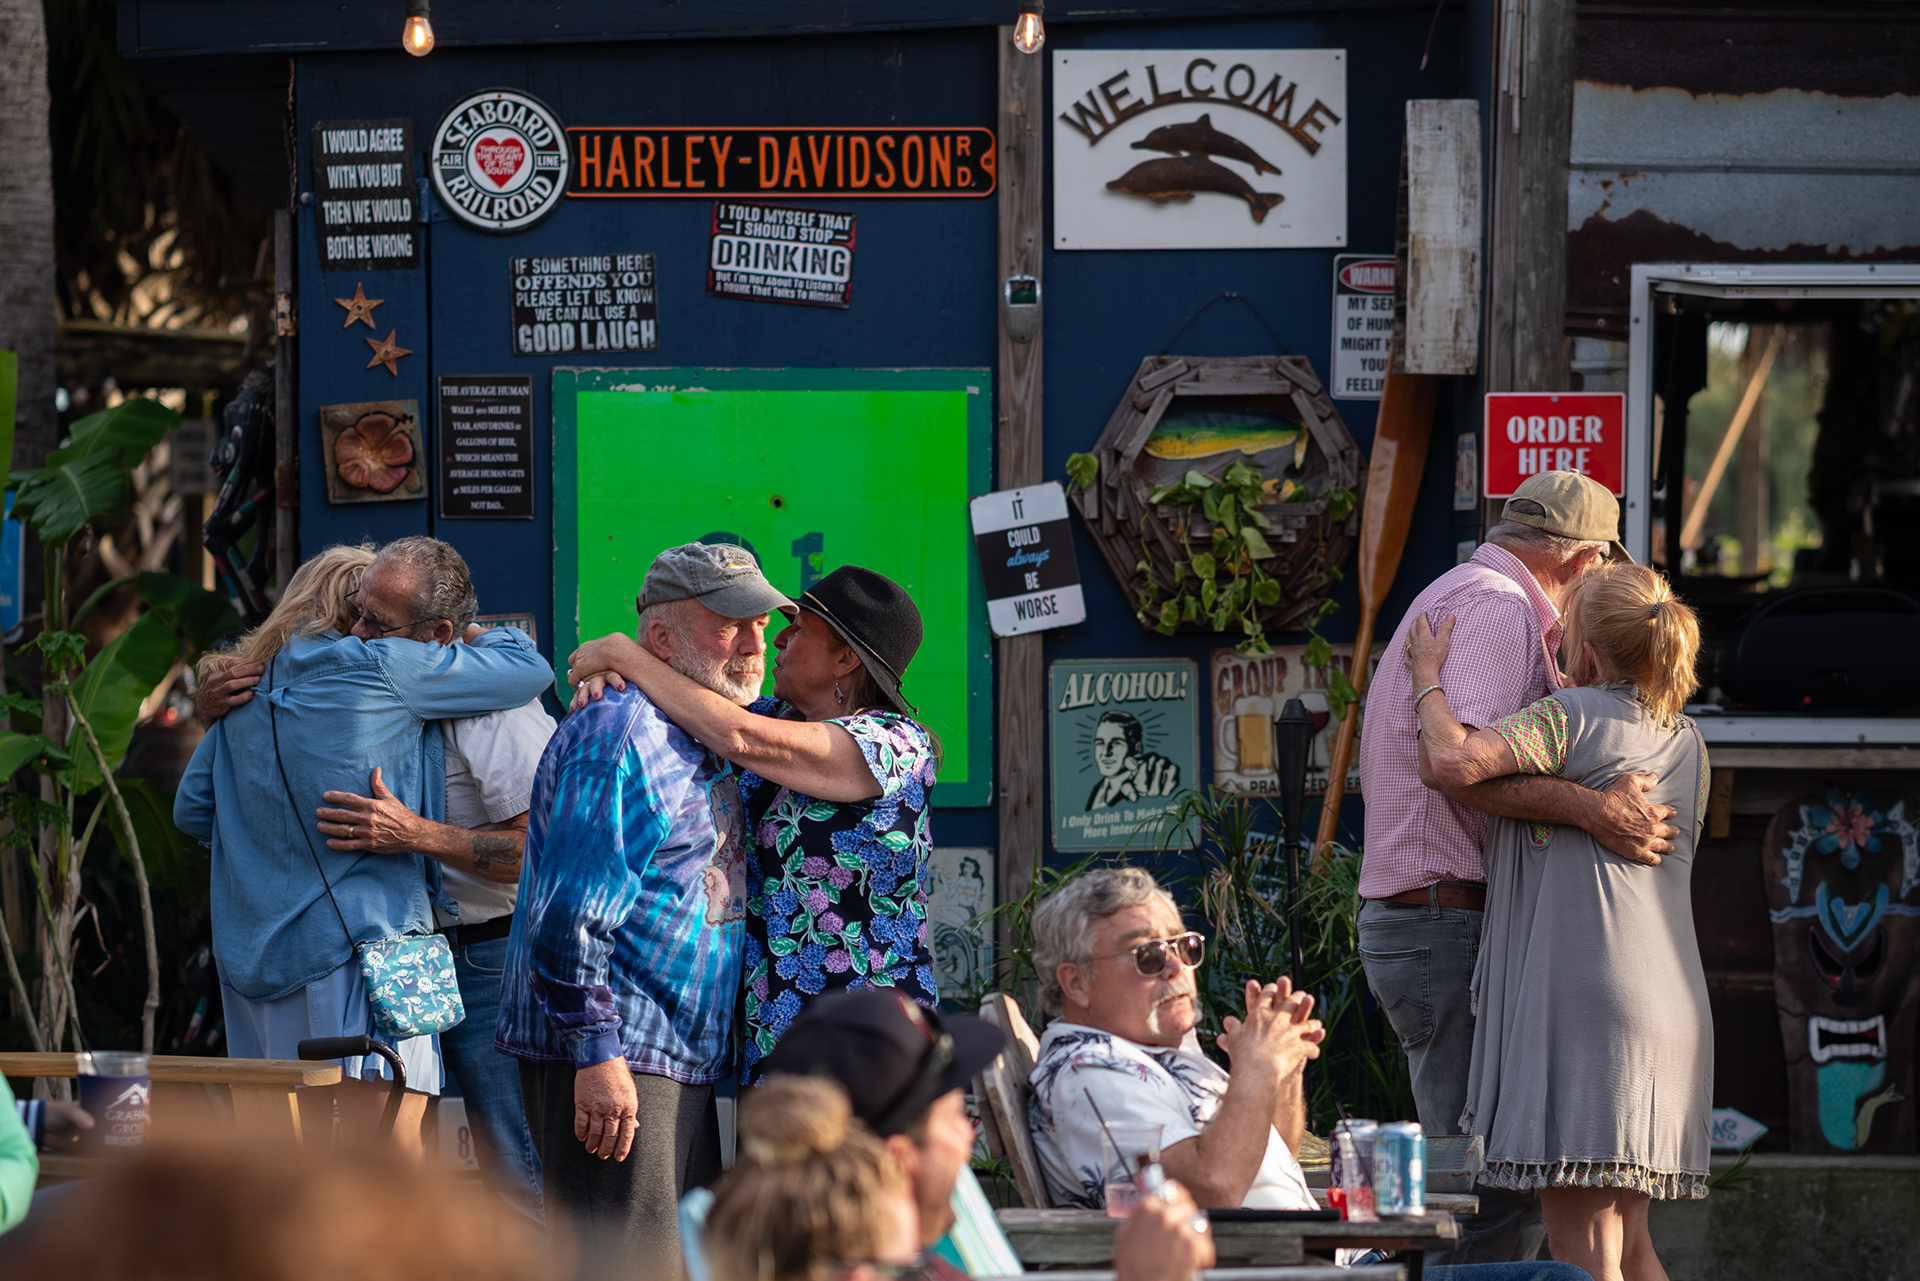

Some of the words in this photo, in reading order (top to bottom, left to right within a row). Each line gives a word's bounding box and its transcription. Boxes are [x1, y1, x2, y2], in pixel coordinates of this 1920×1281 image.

[1059, 58, 1341, 156] WELCOME
[445, 101, 553, 147] SEABOARD
[322, 130, 328, 154] I
[328, 129, 368, 154] WOULD
[369, 128, 404, 152] AGREE
[480, 146, 521, 154] THROUGH
[441, 154, 462, 166] AIR
[538, 156, 559, 167] LINE
[477, 153, 492, 161] THE
[495, 153, 523, 161] HEART
[580, 135, 951, 189] HARLEY-DAVIDSON
[327, 165, 357, 189] WITH
[357, 164, 380, 188] YOU
[381, 163, 403, 187] BUT
[446, 174, 553, 220] RAILROAD
[322, 201, 352, 225] THEN
[352, 200, 372, 224] WE
[371, 198, 412, 223] WOULD
[719, 204, 725, 219] I
[728, 205, 761, 222] TOLD
[764, 209, 816, 227] MYSELF
[818, 214, 852, 231] THAT
[744, 222, 796, 240] SHOULD
[799, 227, 834, 244] STOP
[326, 235, 356, 260] BOTH
[356, 235, 372, 259] BE
[371, 233, 413, 258] WRONG
[515, 258, 527, 275] IF
[532, 256, 612, 274] SOMETHING
[617, 254, 652, 271] HERE
[716, 238, 846, 277] DRINKING
[515, 274, 607, 291] OFFENDS
[609, 271, 652, 288] YOU
[1350, 267, 1395, 286] WARNI
[516, 290, 563, 308] PLEASE
[566, 290, 591, 306] LET
[595, 289, 612, 305] US
[616, 288, 653, 304] KNOW
[1348, 297, 1367, 311] MY
[1371, 297, 1394, 311] SEN
[535, 308, 554, 322] WE
[555, 307, 579, 321] CAN
[582, 306, 602, 321] ALL
[605, 305, 626, 320] USE
[629, 305, 638, 319] A
[1347, 317, 1363, 331] OF
[1366, 317, 1394, 331] HUM
[518, 322, 575, 353] GOOD
[580, 319, 656, 350] LAUGH
[1341, 337, 1381, 351] MIGHT
[1360, 358, 1387, 372] YOU
[441, 386, 460, 396] THE
[460, 385, 497, 396] AVERAGE
[497, 385, 530, 396] HUMAN
[1346, 378, 1384, 392] FEELI
[508, 405, 522, 415] PER
[472, 421, 488, 431] AND
[1506, 415, 1603, 444] ORDER
[487, 437, 497, 447] OF
[1518, 448, 1592, 475] HERE
[1012, 499, 1024, 520] IT
[1007, 526, 1041, 548] COULD
[1006, 549, 1050, 568] always
[1024, 571, 1040, 591] BE
[1014, 594, 1059, 621] WORSE
[1059, 671, 1188, 712] ALCOHOL!
[1218, 656, 1287, 715] GROUP
[1062, 817, 1067, 828] I
[1068, 814, 1092, 829] Only
[1093, 811, 1121, 826] Drink
[1123, 809, 1134, 822] To
[1083, 827, 1108, 839] More
[112, 1122, 144, 1135] GROU
